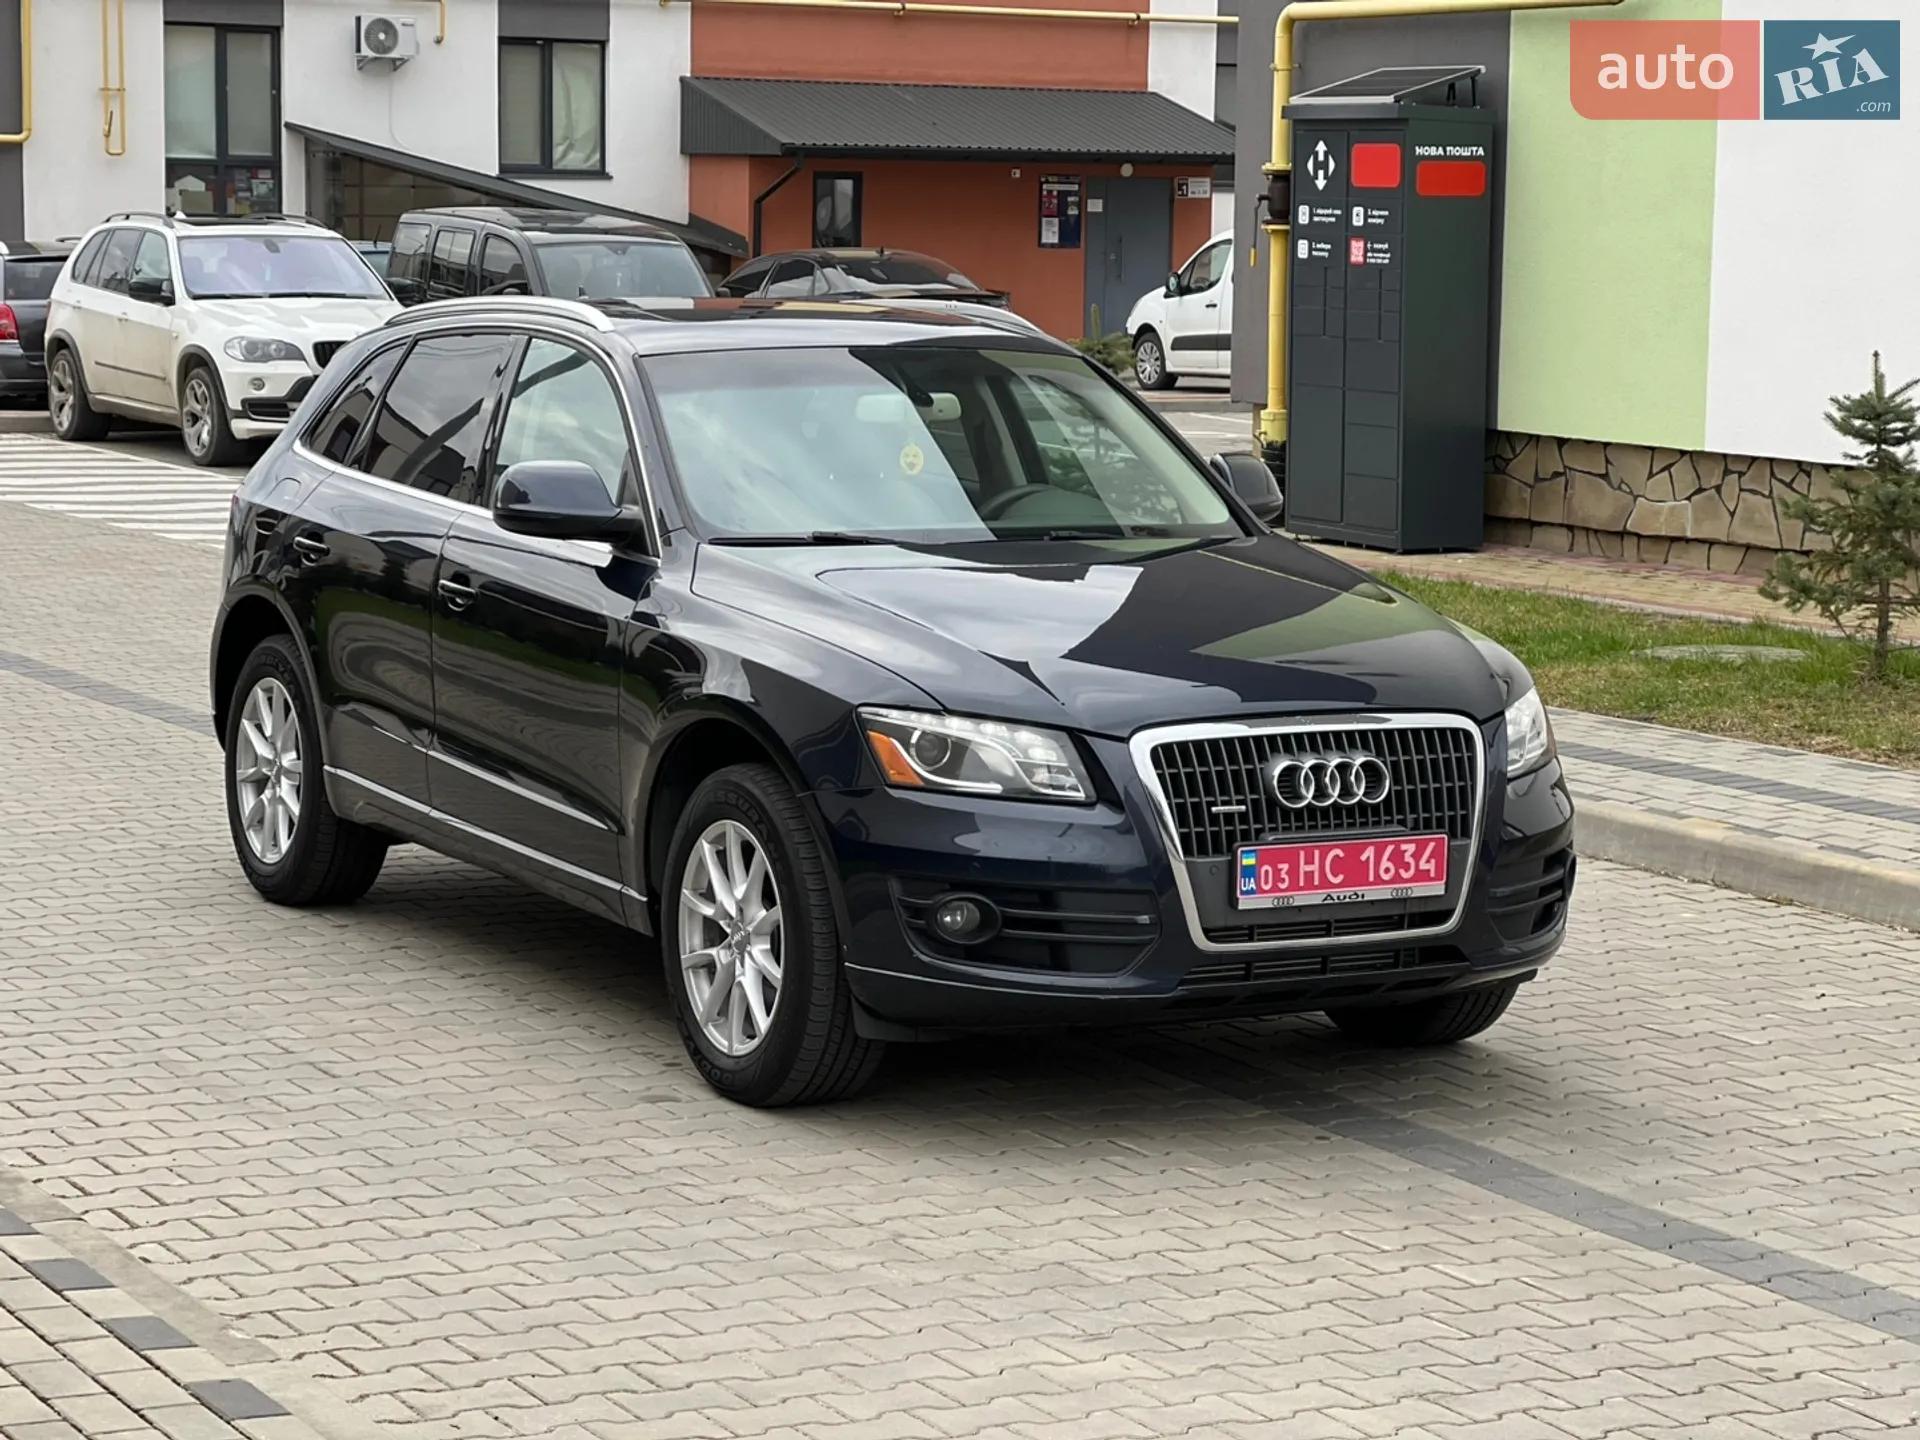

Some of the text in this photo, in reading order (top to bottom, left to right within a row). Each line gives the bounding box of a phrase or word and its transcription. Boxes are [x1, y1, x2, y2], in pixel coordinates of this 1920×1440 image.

[1415, 145, 1485, 156] НОВА ПОШТА
[1260, 841, 1437, 891] 03 HC 1634
[1241, 878, 1257, 891] UA
[1322, 891, 1366, 903] Audi
